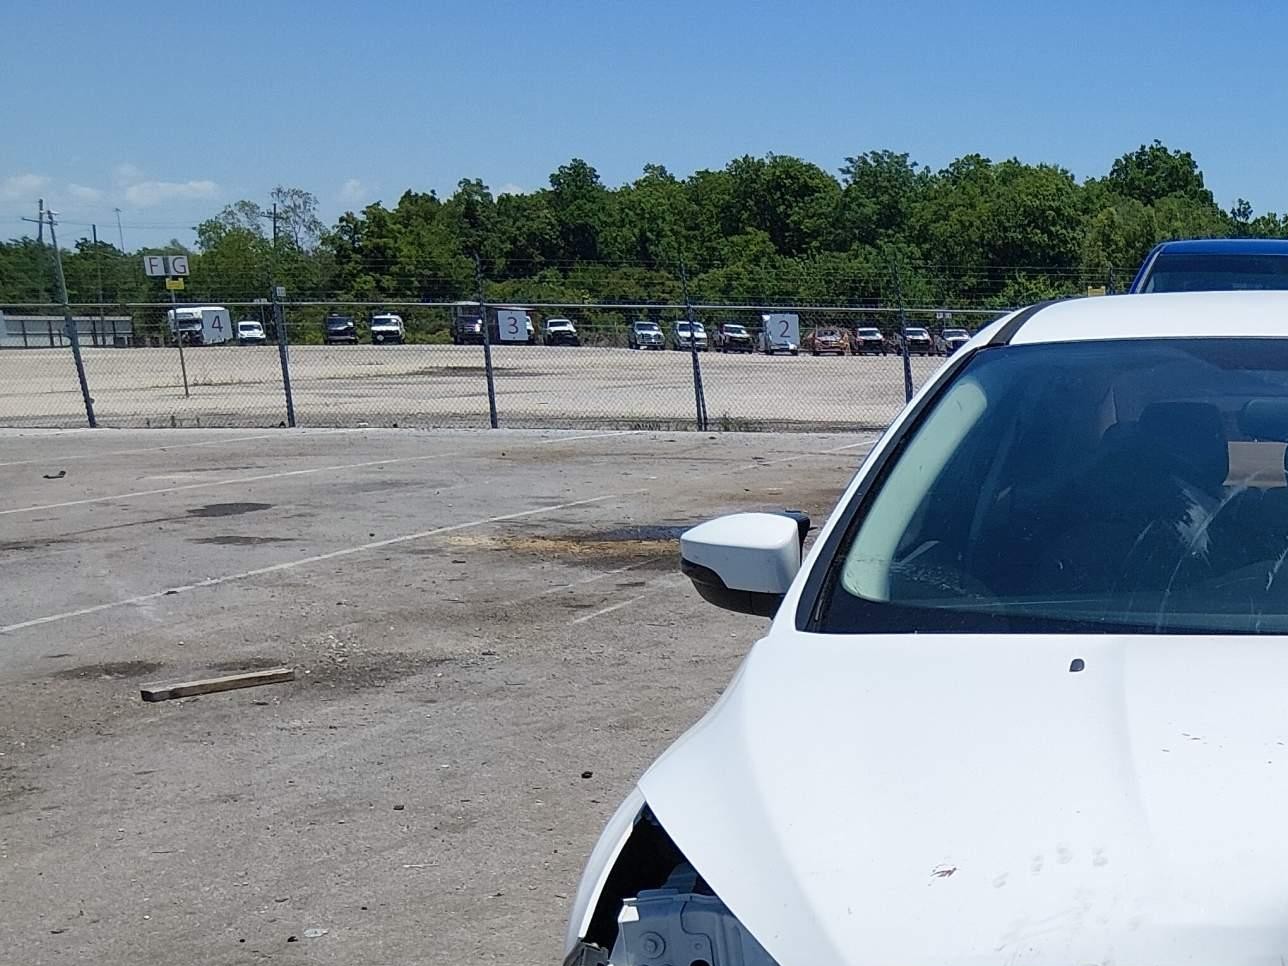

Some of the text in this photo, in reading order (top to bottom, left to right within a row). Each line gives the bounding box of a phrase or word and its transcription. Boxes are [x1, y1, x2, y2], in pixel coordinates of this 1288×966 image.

[148, 256, 187, 275] F G
[211, 315, 224, 333] 4
[507, 316, 519, 335] 3
[777, 320, 791, 338] 2
